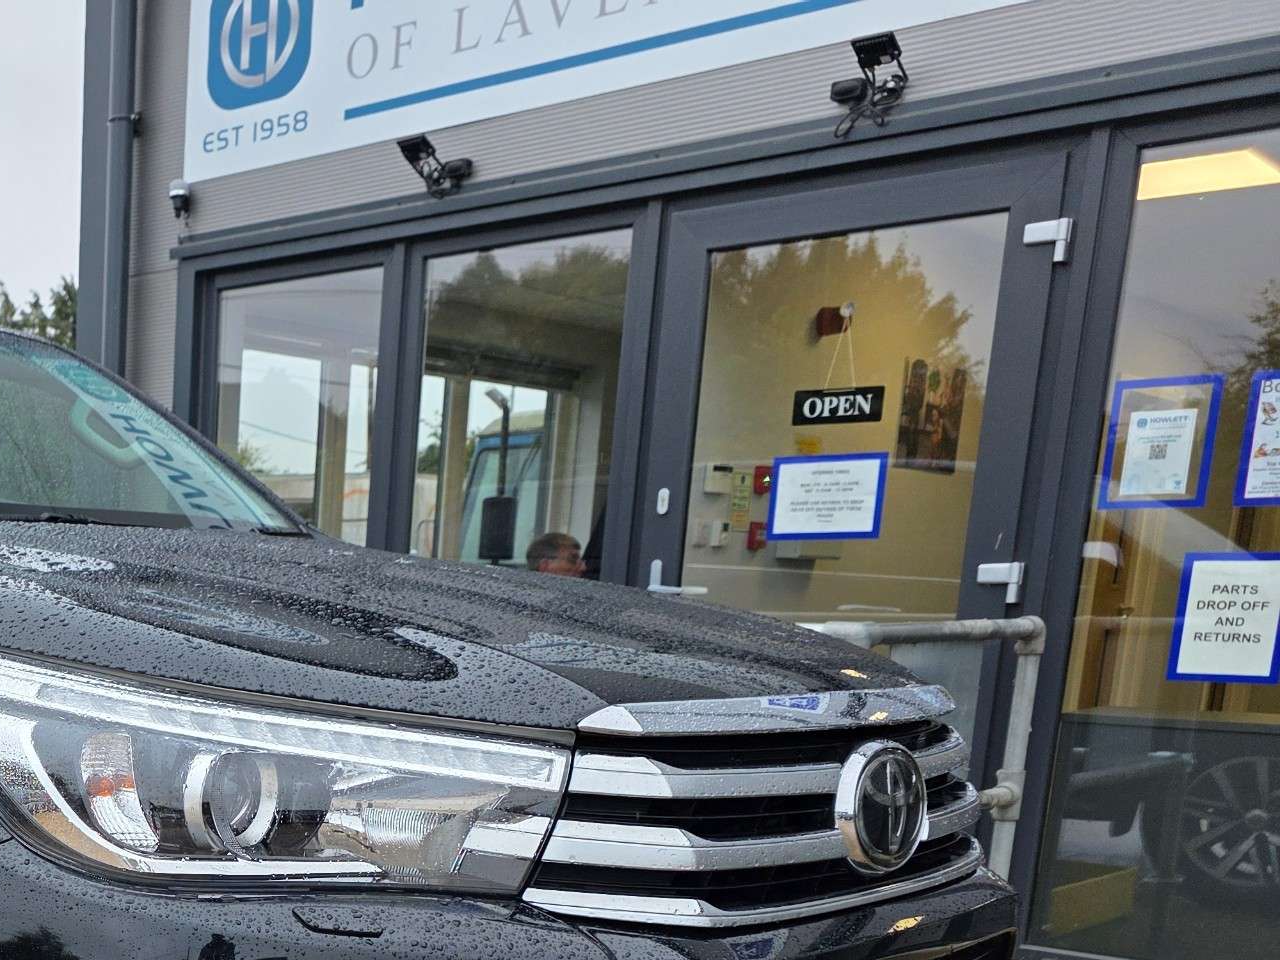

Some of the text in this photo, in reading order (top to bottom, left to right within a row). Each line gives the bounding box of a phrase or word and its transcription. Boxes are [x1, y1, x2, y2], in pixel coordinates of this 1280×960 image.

[346, 20, 418, 80] OF
[202, 110, 309, 153] EST 1958
[803, 393, 873, 419] OPEN
[1211, 584, 1259, 595] PARTS
[1196, 600, 1270, 611] DROP OFF
[1214, 616, 1245, 627] AND
[1193, 632, 1261, 644] RETURNS
